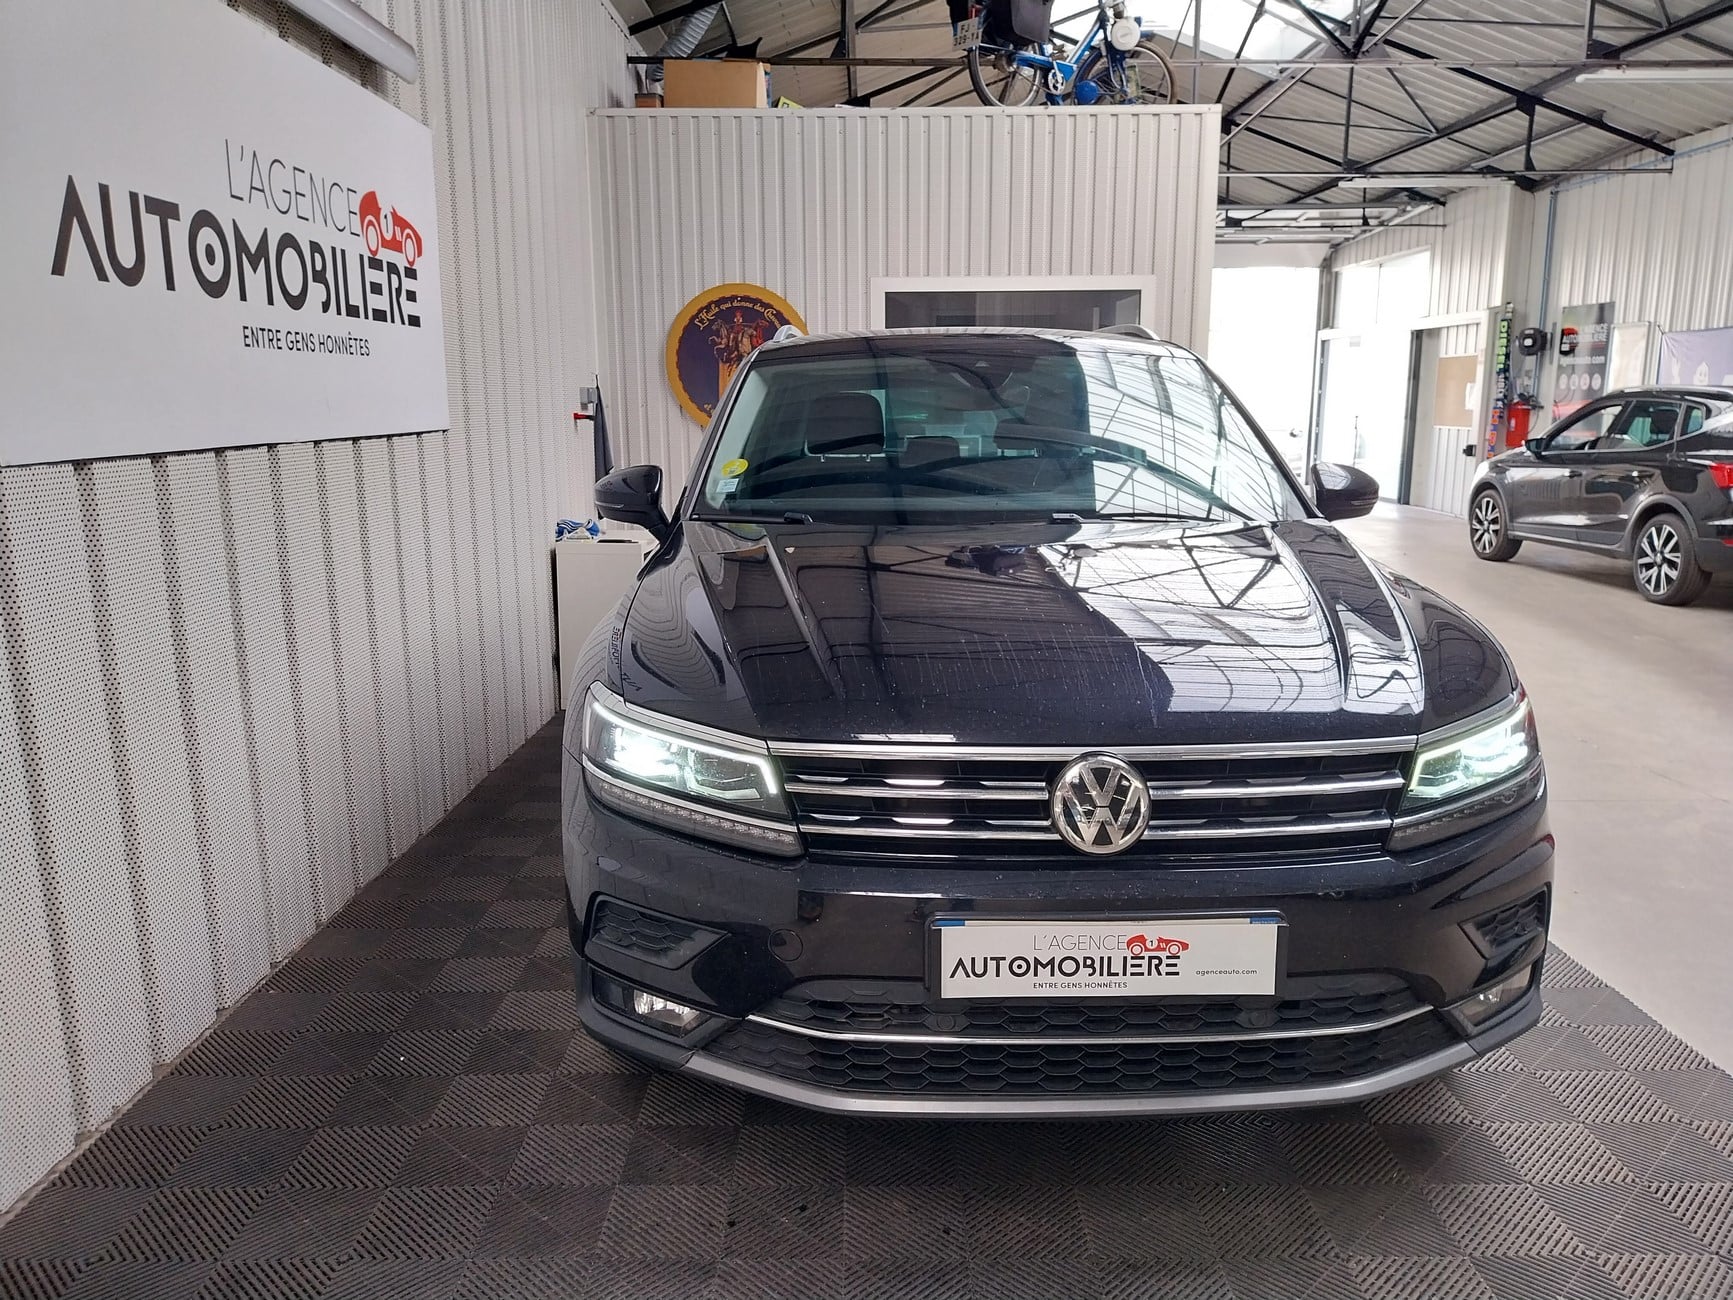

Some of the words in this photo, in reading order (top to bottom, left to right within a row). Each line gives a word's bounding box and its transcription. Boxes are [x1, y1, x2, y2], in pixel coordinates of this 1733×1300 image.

[225, 138, 360, 238] L'AGENCE
[720, 301, 732, 310] qui
[732, 300, 754, 308] donne
[754, 303, 765, 312] des
[243, 325, 283, 351] ENTRE
[285, 332, 317, 353] GENS
[318, 332, 371, 357] HONNÊTES
[1033, 934, 1127, 951] L'AGENCE
[1196, 969, 1258, 978] agenceauto.com
[1084, 980, 1128, 989] HONNÊTES
